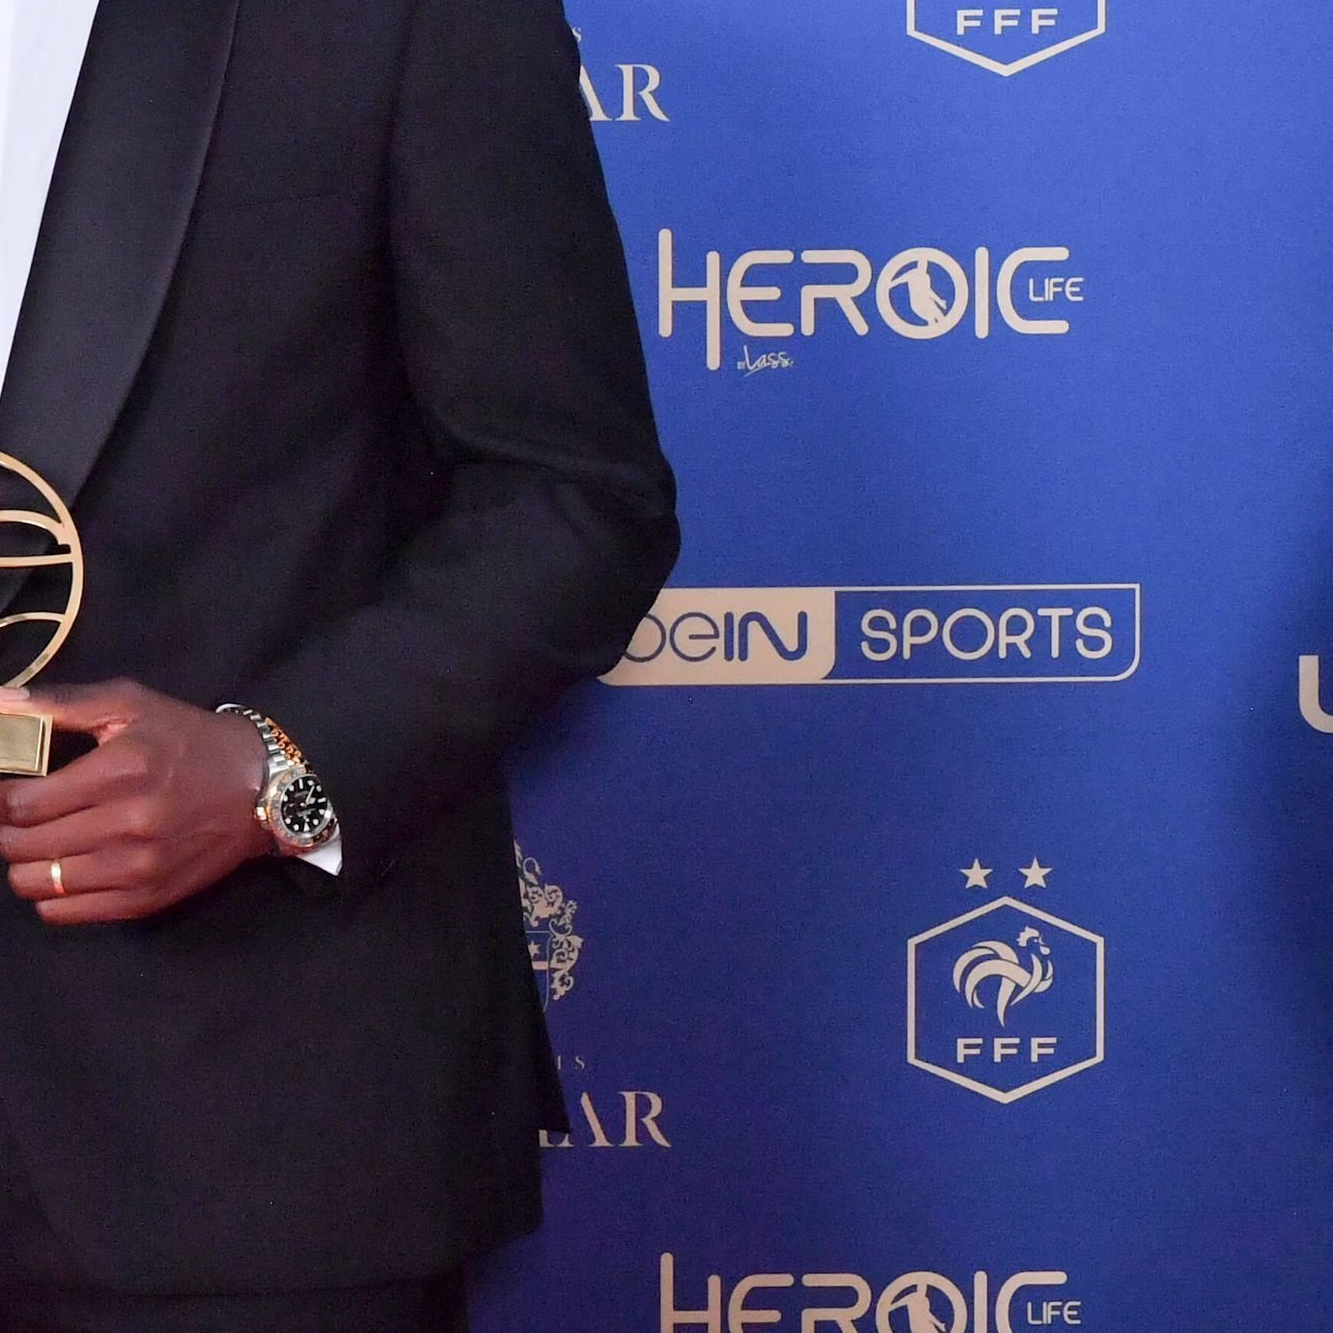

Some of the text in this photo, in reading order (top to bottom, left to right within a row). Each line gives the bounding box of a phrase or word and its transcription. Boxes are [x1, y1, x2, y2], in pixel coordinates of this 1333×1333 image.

[957, 9, 1058, 35] FFF
[659, 229, 1083, 370] HEROIC LIFE
[862, 607, 1112, 660] SPORTS
[957, 1038, 1056, 1063] FFF
[1028, 1301, 1081, 1324] LIFE
